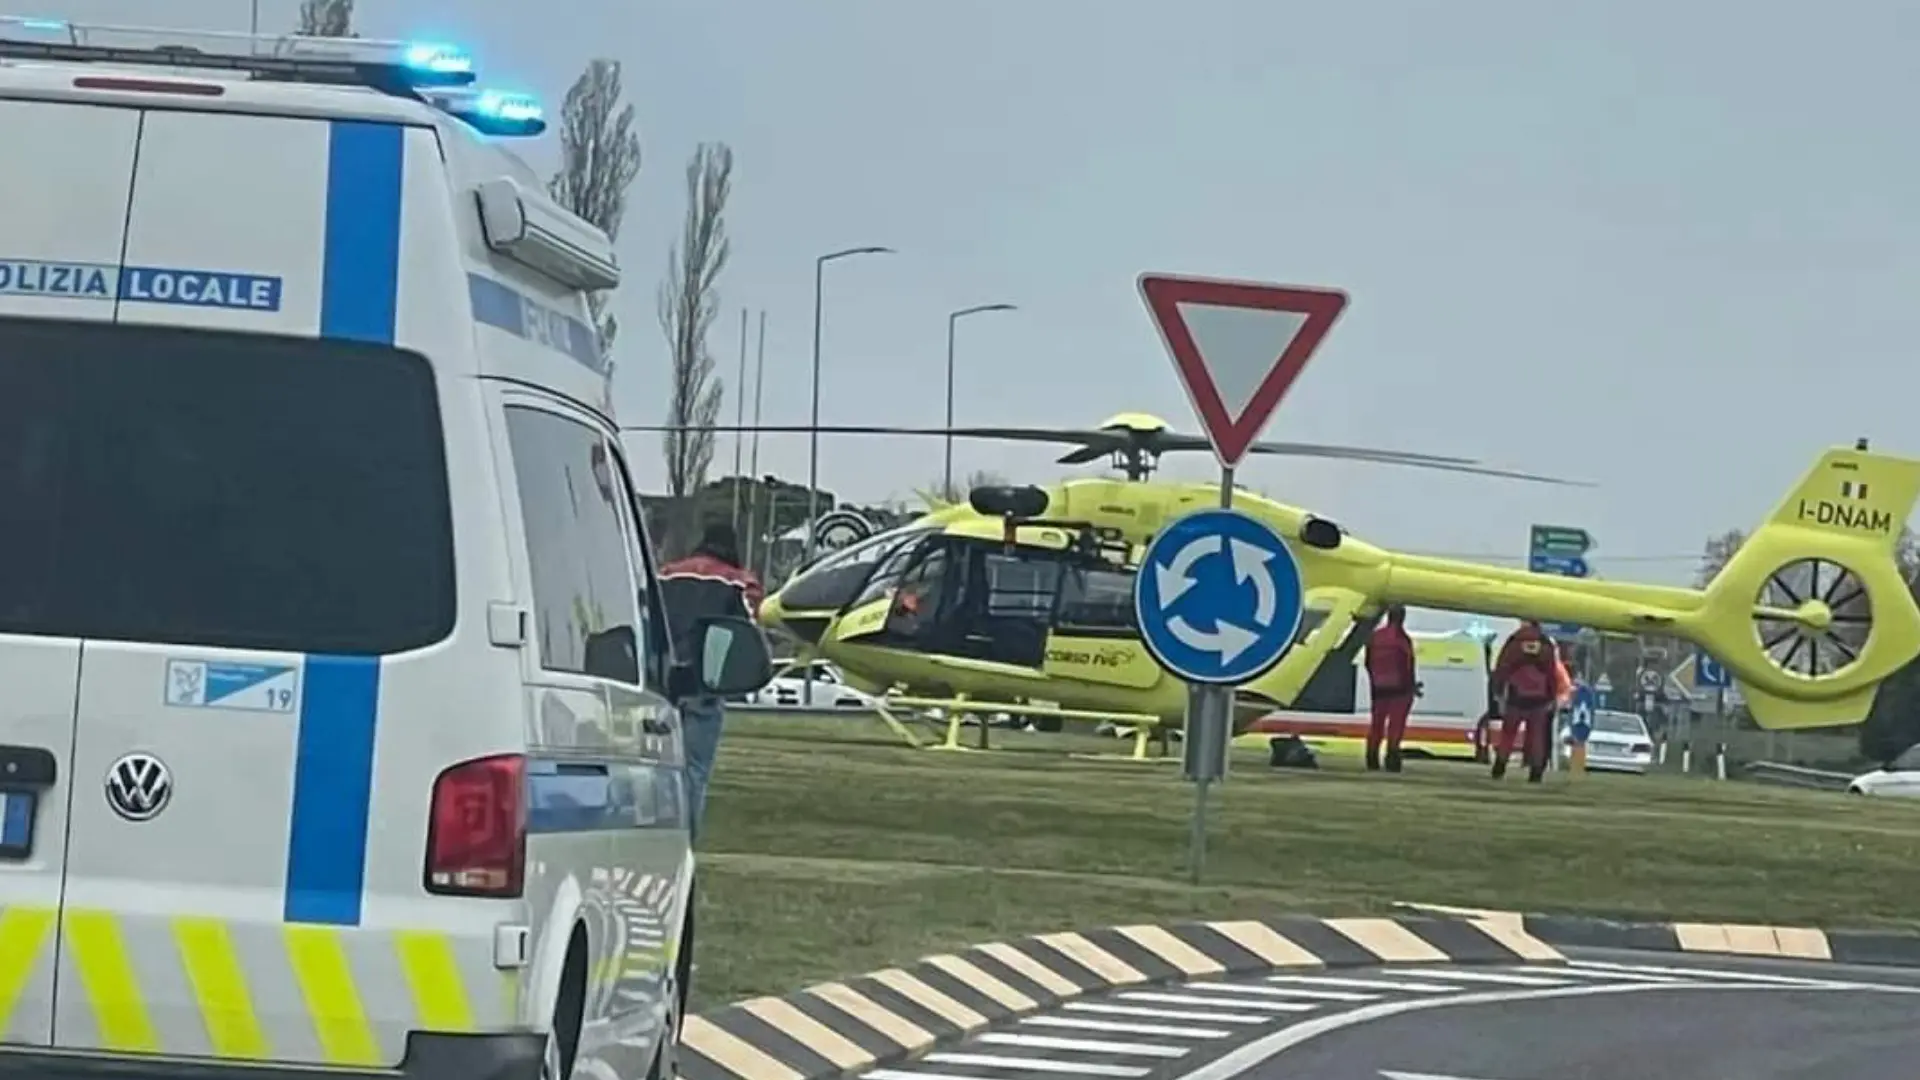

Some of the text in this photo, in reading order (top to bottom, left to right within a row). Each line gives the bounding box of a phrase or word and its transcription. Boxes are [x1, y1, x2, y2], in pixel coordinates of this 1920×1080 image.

[129, 270, 273, 306] LOCALE
[1798, 499, 1891, 532] I-DNAM
[267, 687, 291, 709] 19
